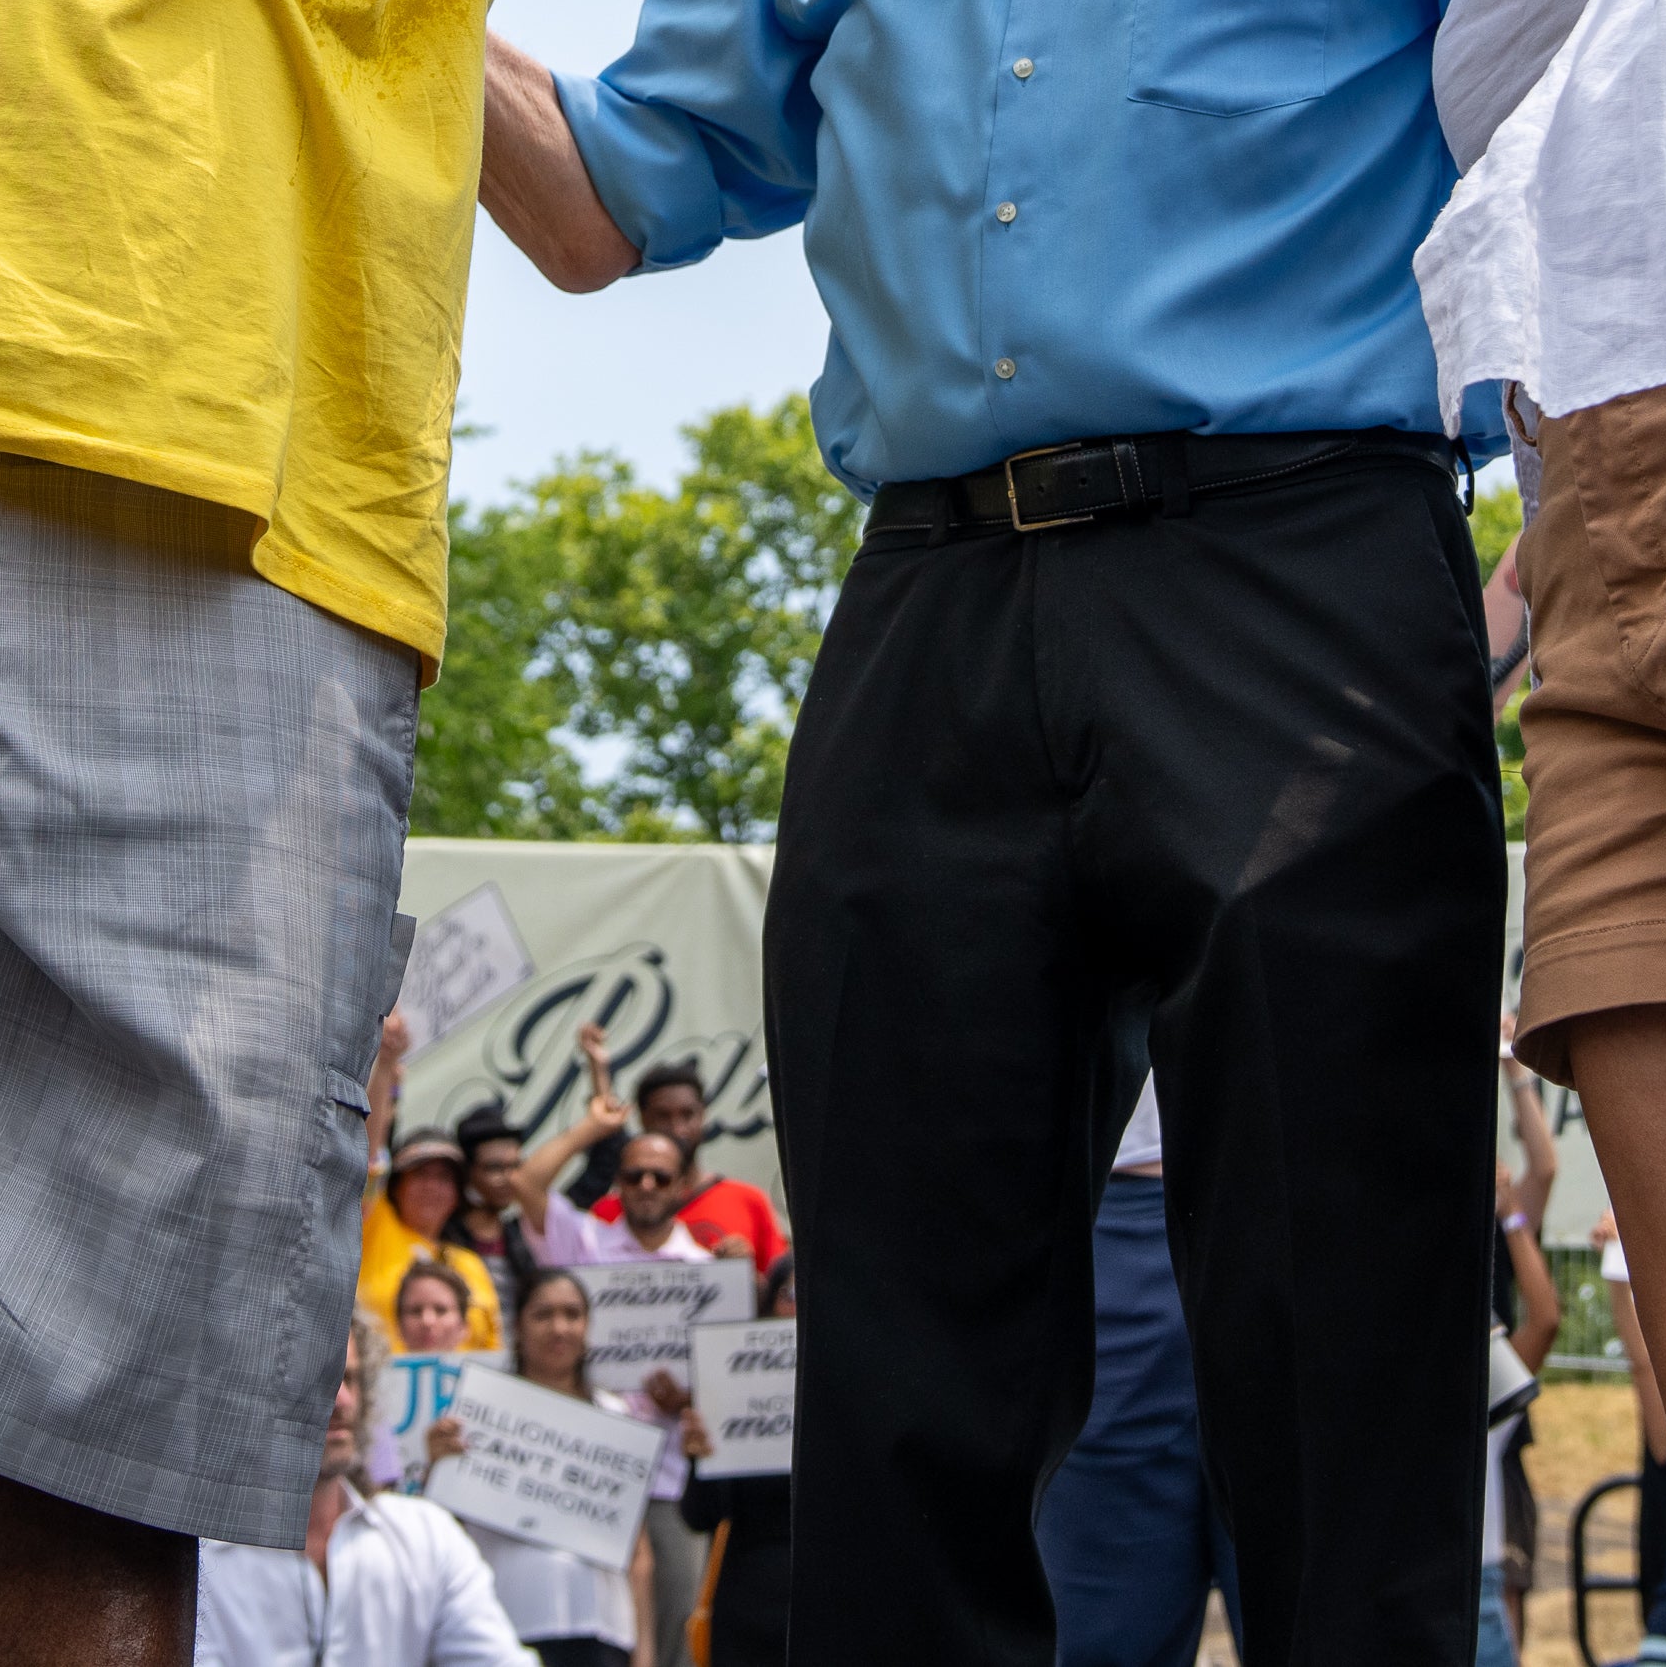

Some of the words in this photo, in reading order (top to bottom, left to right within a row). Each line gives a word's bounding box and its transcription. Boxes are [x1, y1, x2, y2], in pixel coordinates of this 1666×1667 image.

[592, 1284, 721, 1321] many
[455, 1395, 652, 1480] BILLIONAIRES
[467, 1430, 558, 1475] CAN'T
[562, 1462, 624, 1499] BUY
[455, 1456, 514, 1489] THE
[515, 1475, 622, 1530] BRONX
